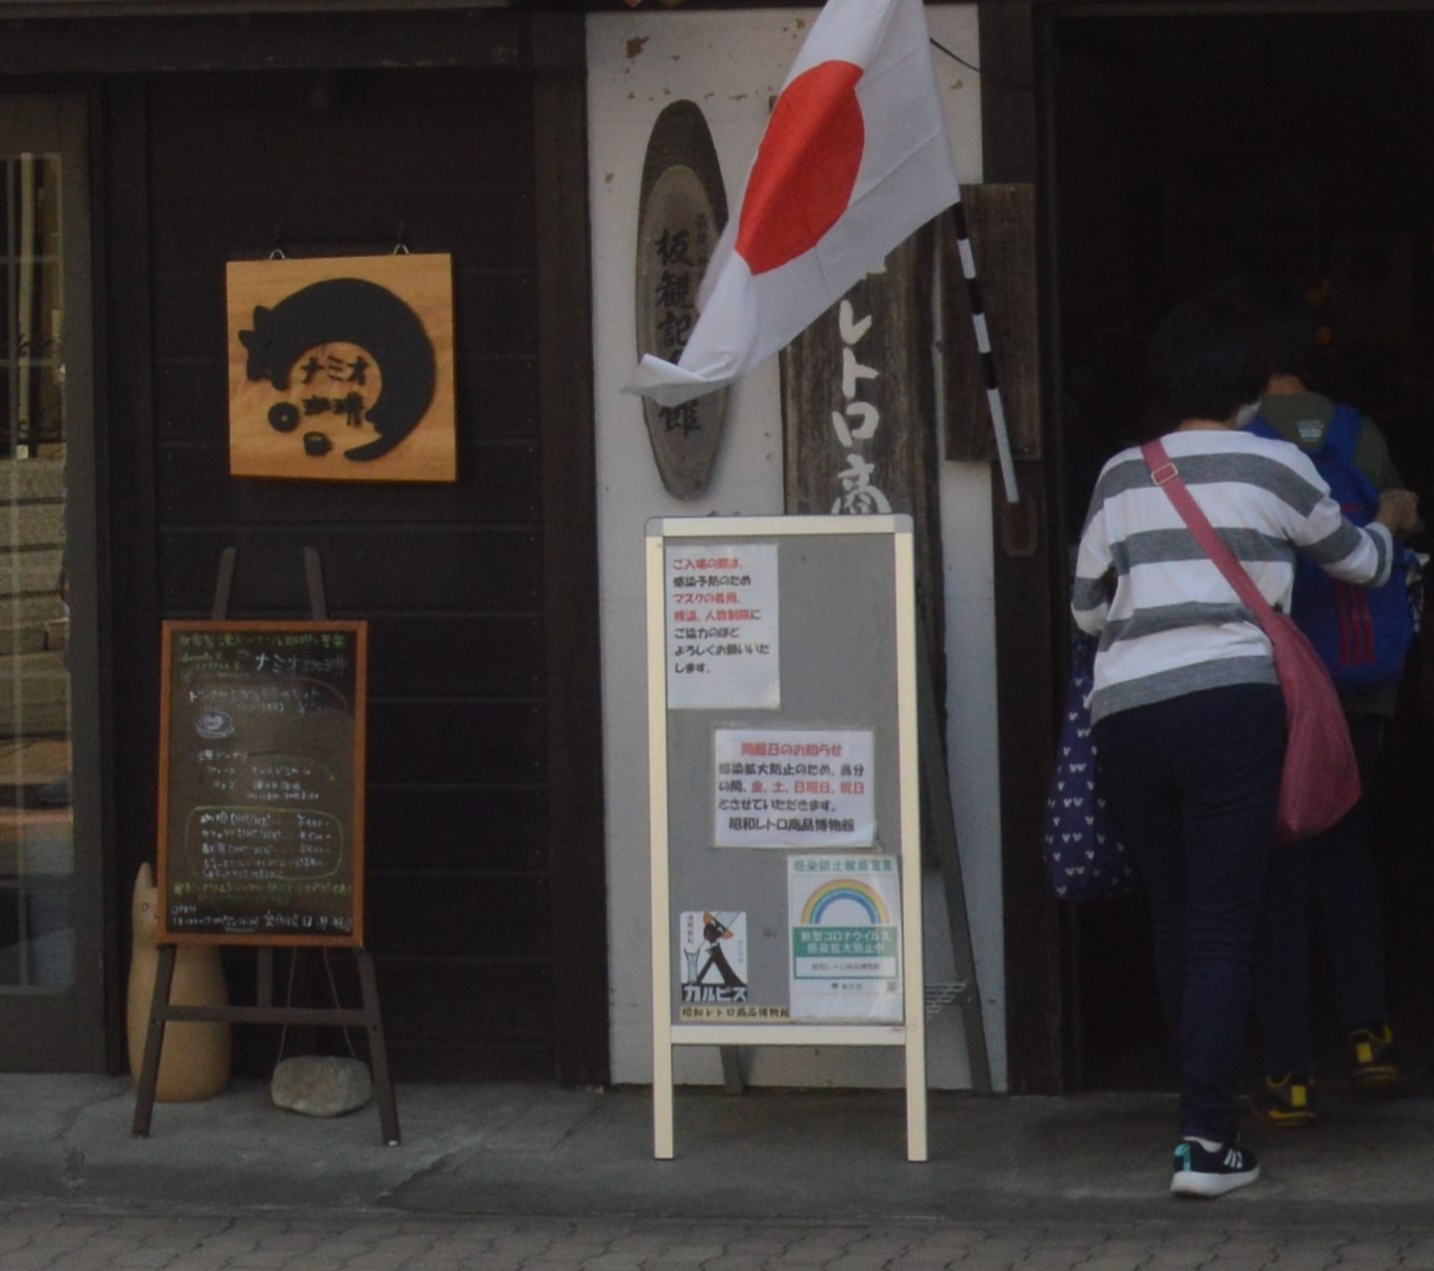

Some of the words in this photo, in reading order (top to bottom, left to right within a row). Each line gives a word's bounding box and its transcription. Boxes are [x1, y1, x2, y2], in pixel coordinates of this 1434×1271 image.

[654, 227, 702, 439] 板観記館
[300, 354, 370, 386] ナミオ
[300, 391, 366, 428] 珈琲
[728, 817, 855, 832] 昭和レトロ商品博物館
[683, 985, 748, 1002] カルピス
